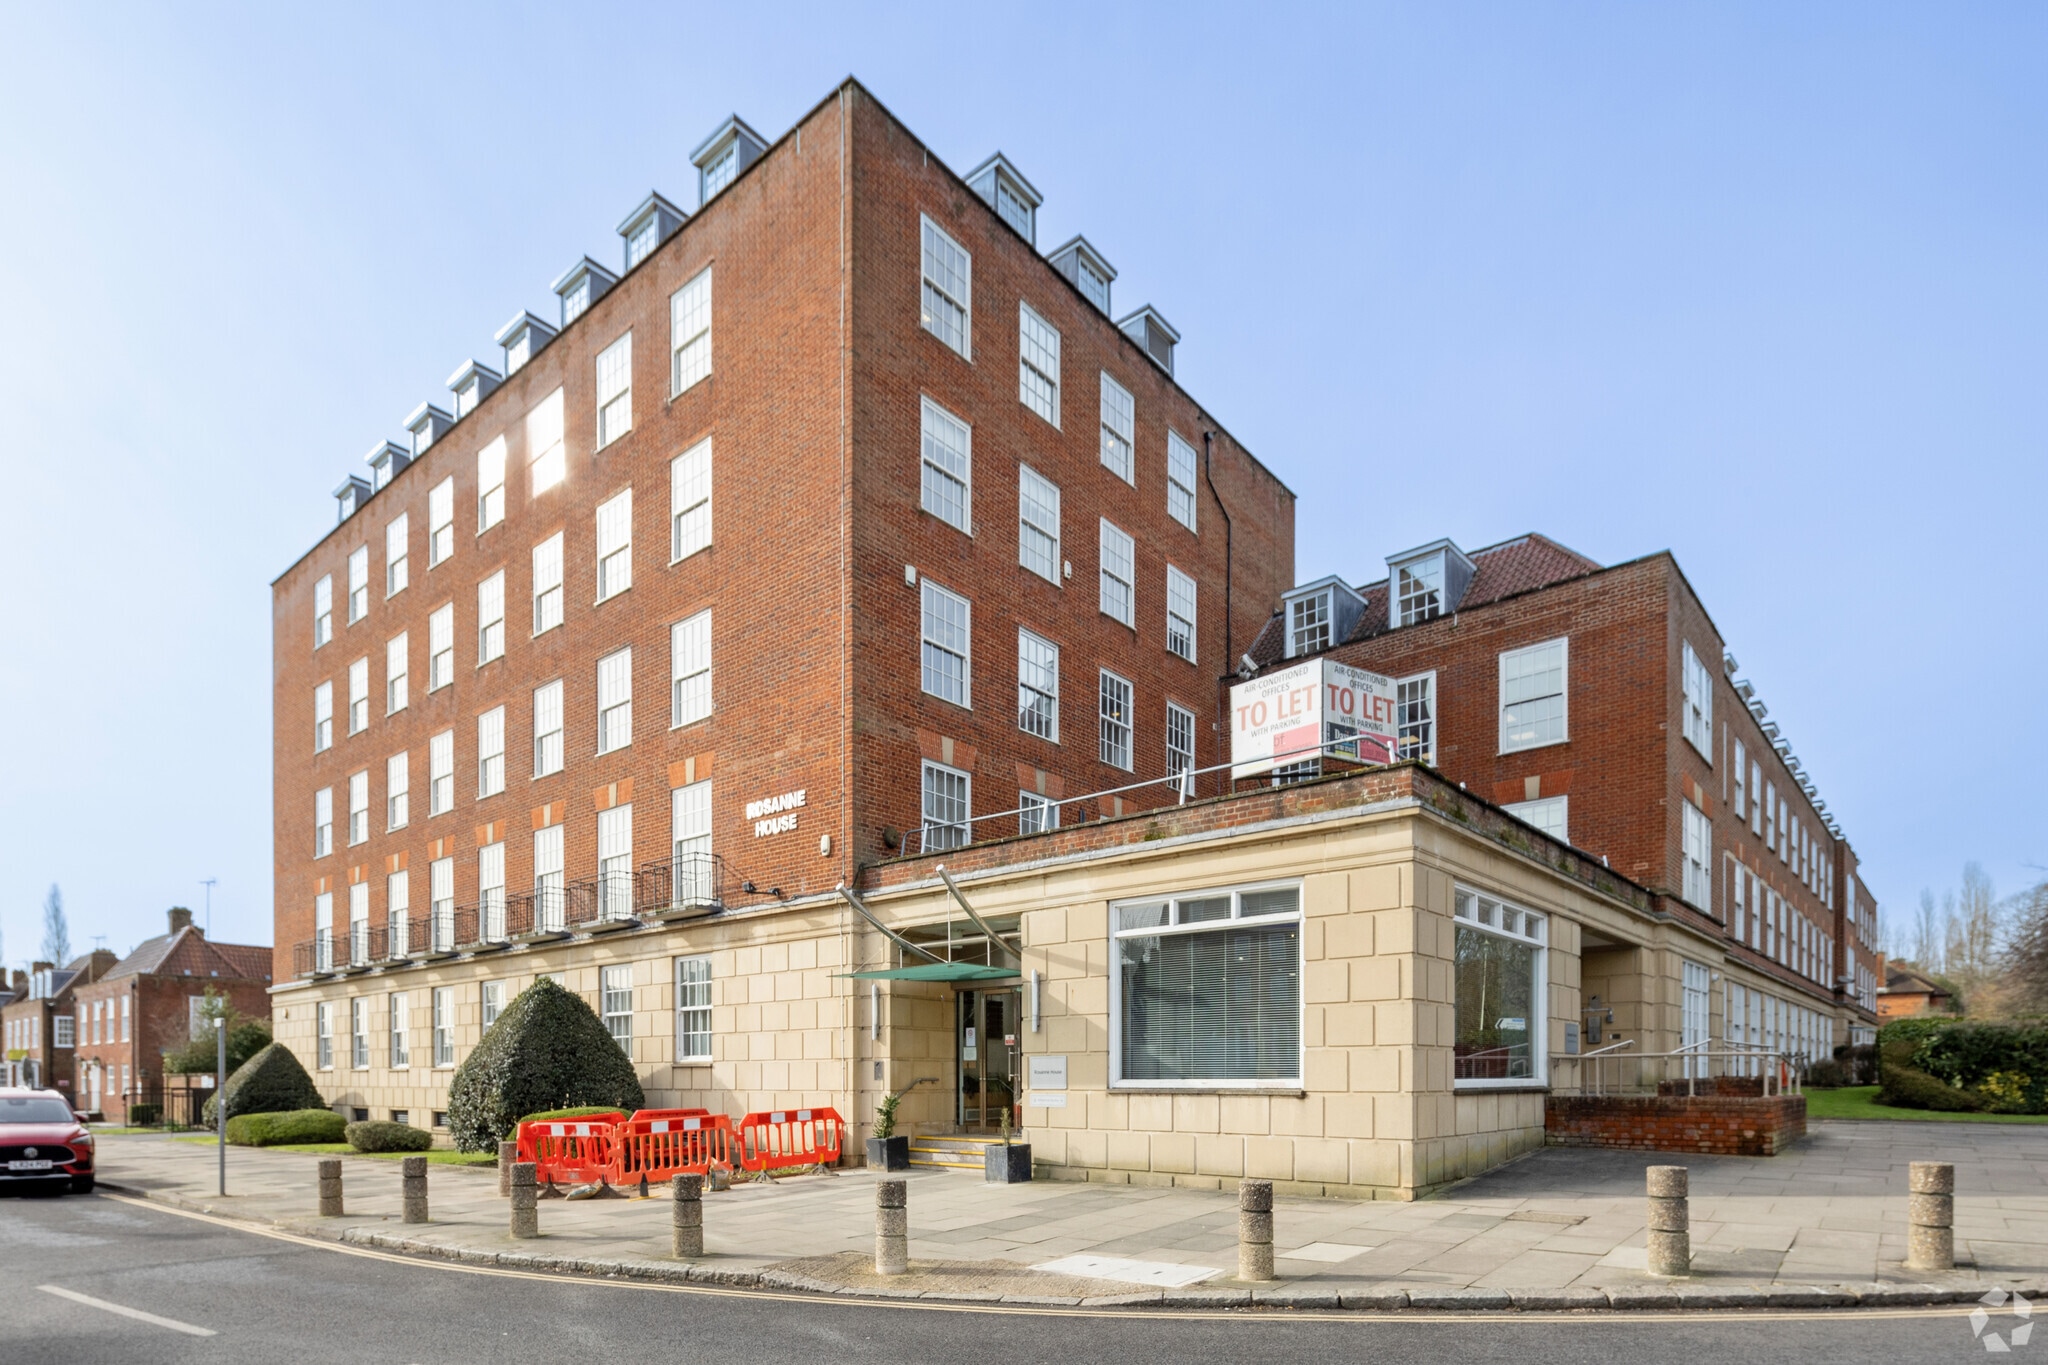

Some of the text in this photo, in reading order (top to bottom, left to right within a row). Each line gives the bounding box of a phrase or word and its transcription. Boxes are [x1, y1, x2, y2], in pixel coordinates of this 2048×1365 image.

[1261, 682, 1290, 698] OFFICES
[1350, 680, 1374, 693] OFFICES
[1237, 683, 1317, 731] TO LET
[1327, 683, 1395, 724] TO LET
[1251, 717, 1301, 738] WITH PARKING
[1340, 715, 1383, 732] WITH PARKING
[746, 789, 806, 820] ROSANNE
[754, 813, 798, 838] HOUSE
